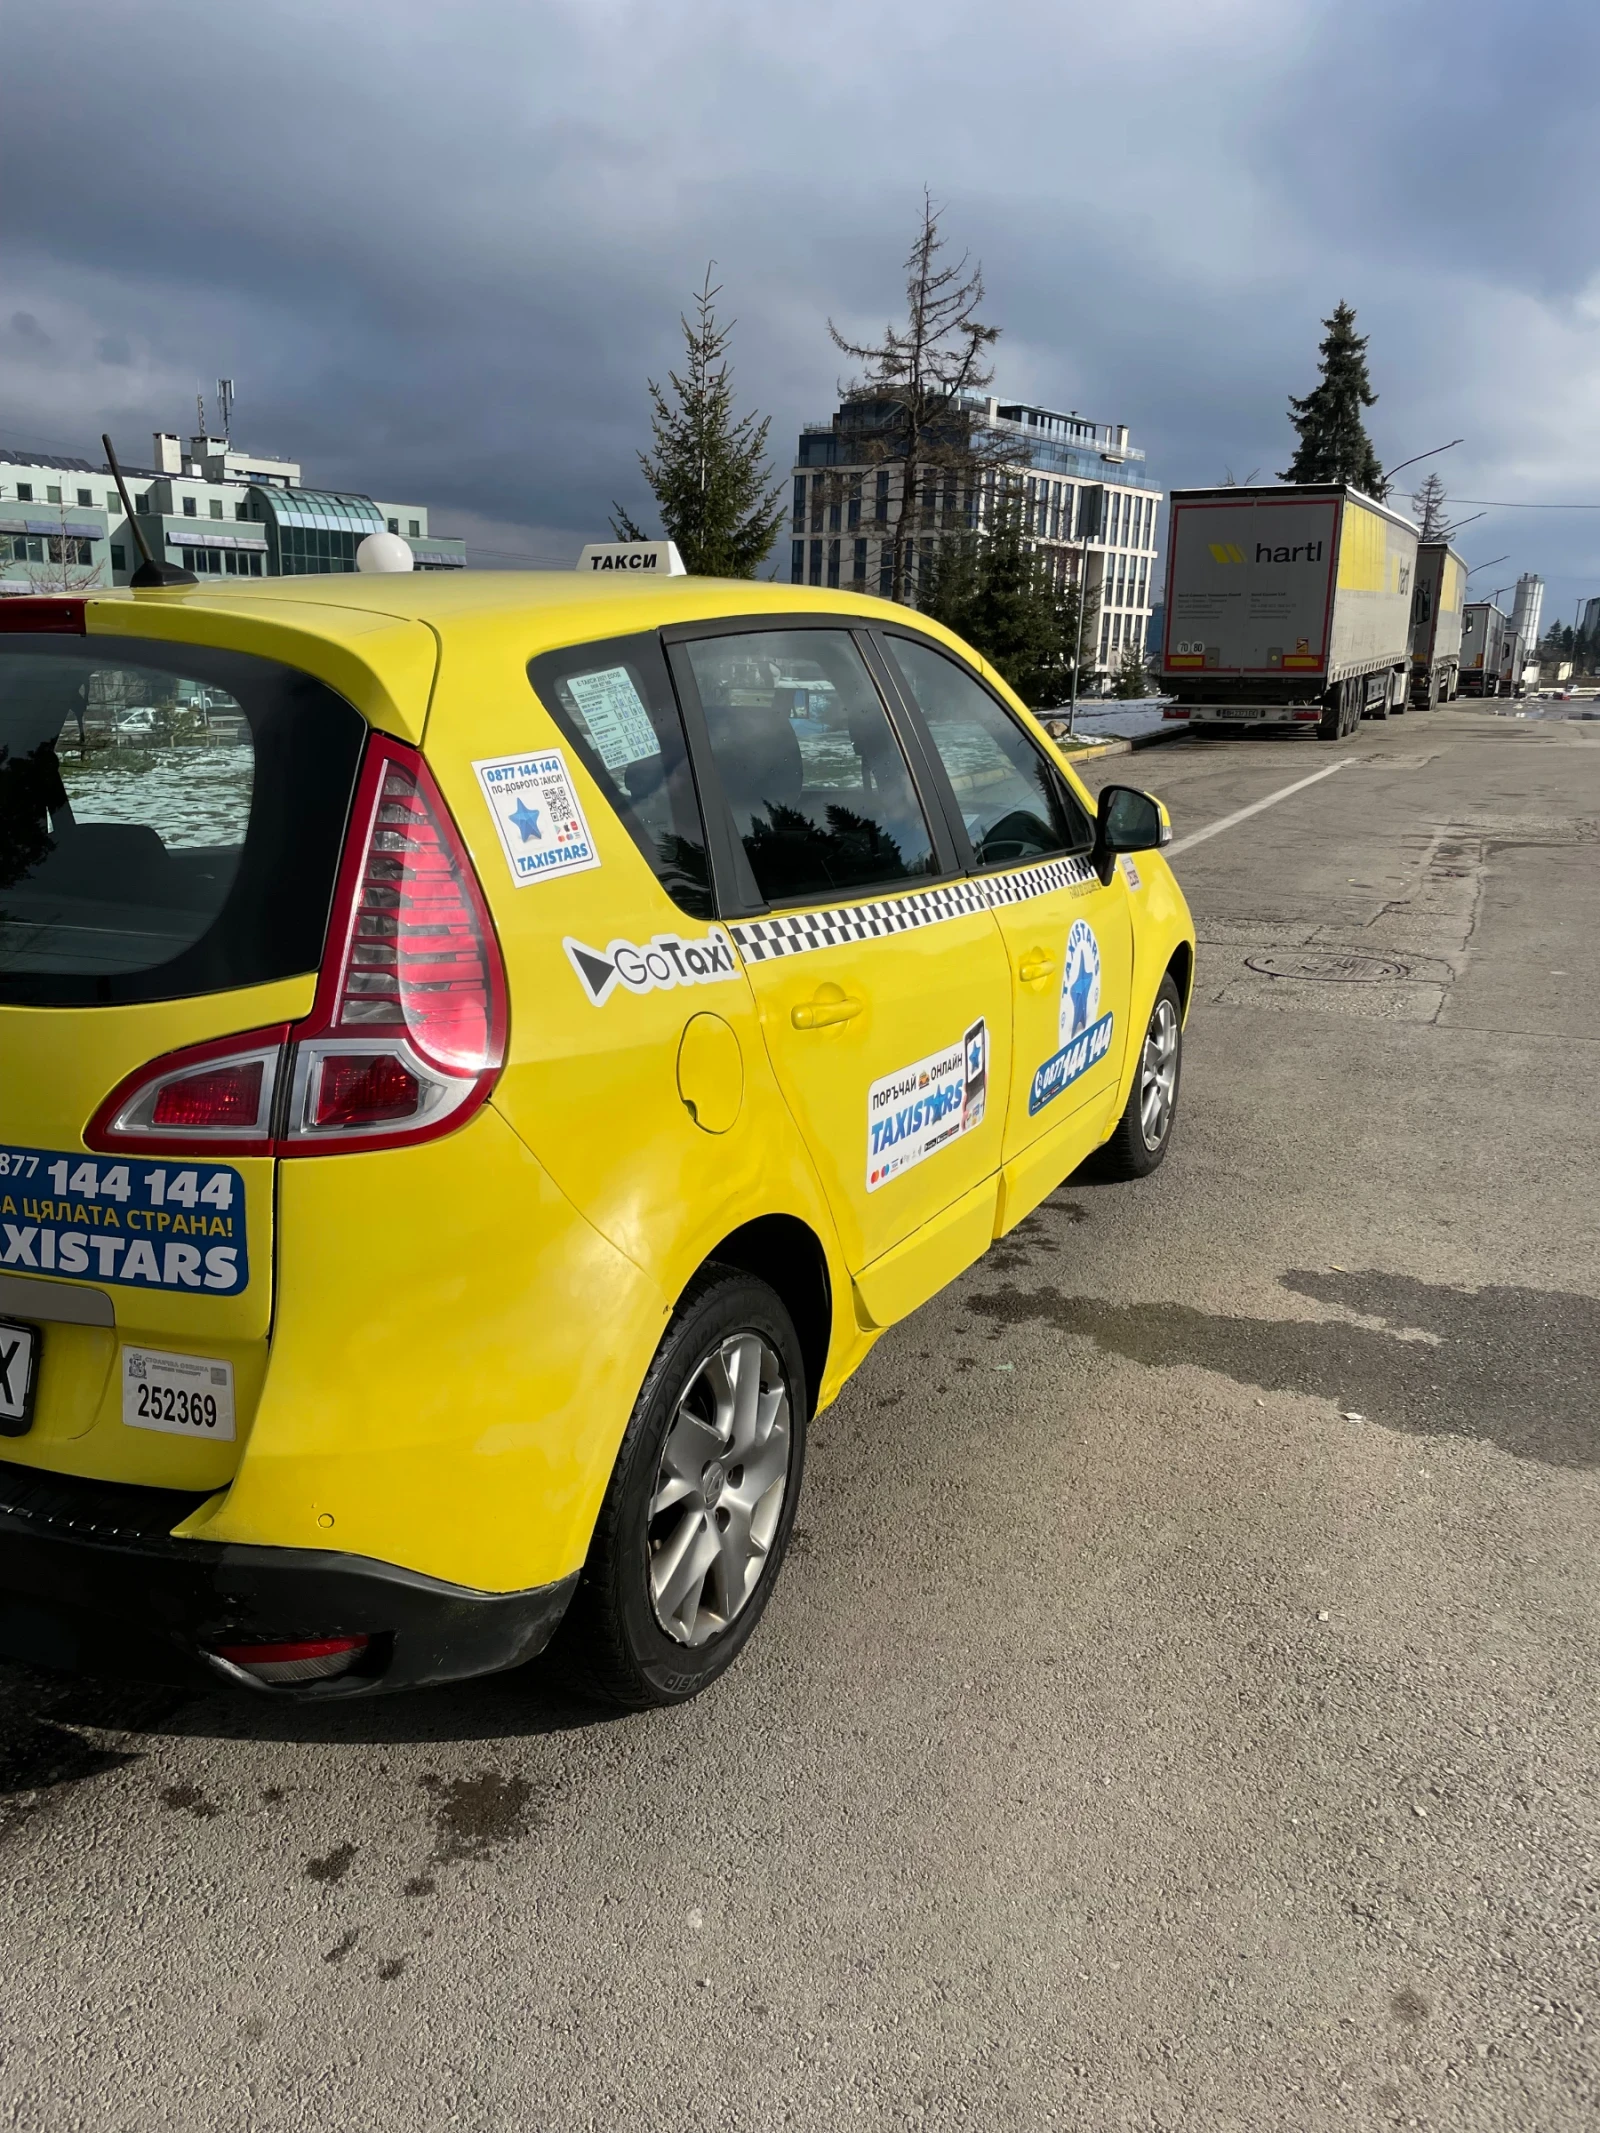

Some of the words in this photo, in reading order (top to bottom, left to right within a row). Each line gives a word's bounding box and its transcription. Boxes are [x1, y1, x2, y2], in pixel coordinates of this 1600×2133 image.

[591, 554, 657, 570] ТАКСИ
[1256, 541, 1322, 563] hartl
[487, 767, 515, 782] 0877
[518, 763, 538, 777] 144
[540, 760, 559, 773] 144
[491, 778, 540, 794] ПО-ДОБРОТО
[540, 773, 564, 786] ТАКСИ!
[517, 843, 588, 872] TAXISTARS
[614, 933, 735, 985] GoTaxi
[1062, 1036, 1089, 1085] 144
[1089, 1017, 1112, 1063] 144
[873, 1073, 917, 1110] ПОРЪЧАЙ
[931, 1053, 963, 1081] ОНЛАЙН
[0, 1152, 40, 1178] 877
[48, 1160, 131, 1202] 144
[144, 1169, 233, 1210] 144
[0, 1195, 17, 1215] А
[23, 1198, 120, 1227] ЦЯЛАТА
[126, 1210, 233, 1237] СТРАНА!
[0, 1223, 238, 1289] XISTARS
[138, 1384, 217, 1428] 252369
